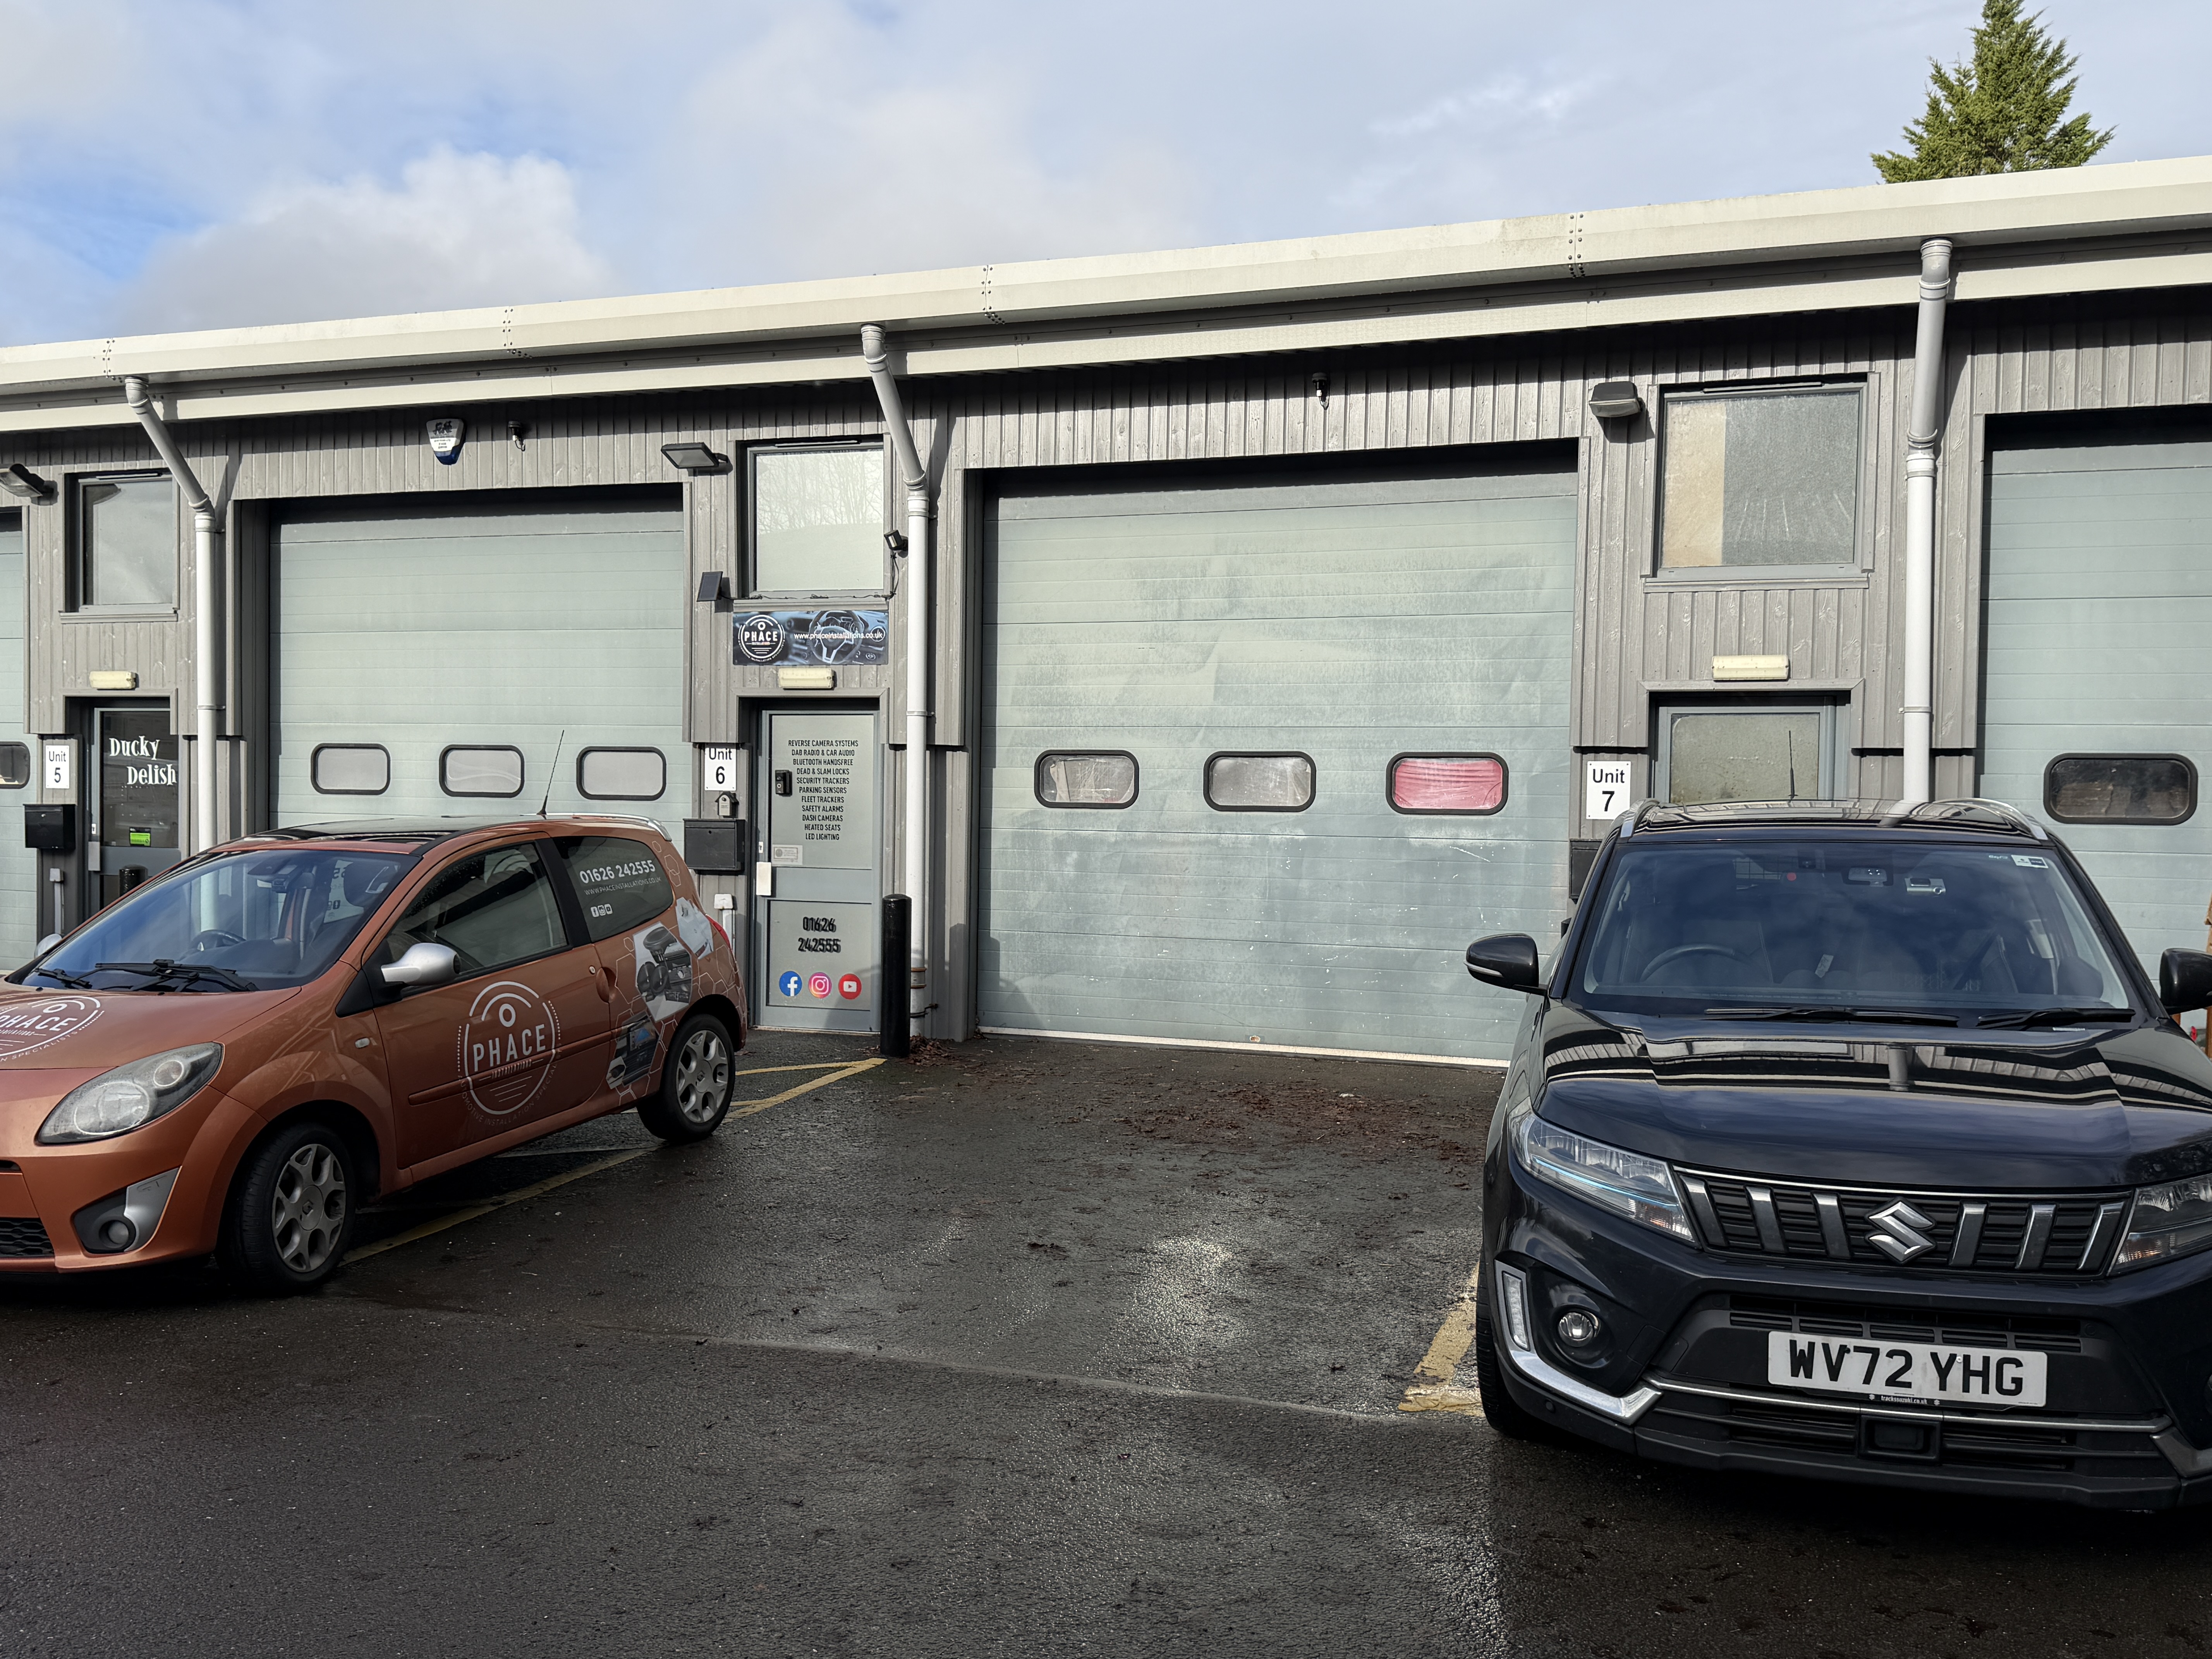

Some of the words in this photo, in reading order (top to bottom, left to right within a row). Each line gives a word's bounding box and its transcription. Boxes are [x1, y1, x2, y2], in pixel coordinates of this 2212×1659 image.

[744, 631, 778, 642] PHACE
[794, 632, 883, 640] www.phaceinstallations.co.uk
[49, 751, 66, 762] Unit
[109, 736, 160, 760] Ducky
[709, 748, 732, 760] Unit
[54, 768, 61, 783] 5
[127, 764, 177, 785] Delish
[716, 766, 725, 784] 6
[1593, 769, 1625, 783] Unit
[1602, 791, 1614, 812] 7
[580, 867, 615, 883] 01626
[616, 860, 656, 877] 242555
[584, 877, 661, 895] WWW.PHACEINSTALLATIONS.CO.UK
[803, 917, 835, 932] 01626
[798, 938, 841, 953] 242555
[12, 1031, 77, 1060] SPECIALISTS
[473, 1024, 546, 1072] PHACE
[492, 1059, 532, 1079] INSTALLATIONS
[484, 1102, 534, 1126] INSTALLATION
[1789, 1339, 1913, 1389] WV72
[1930, 1352, 2024, 1396] YHG
